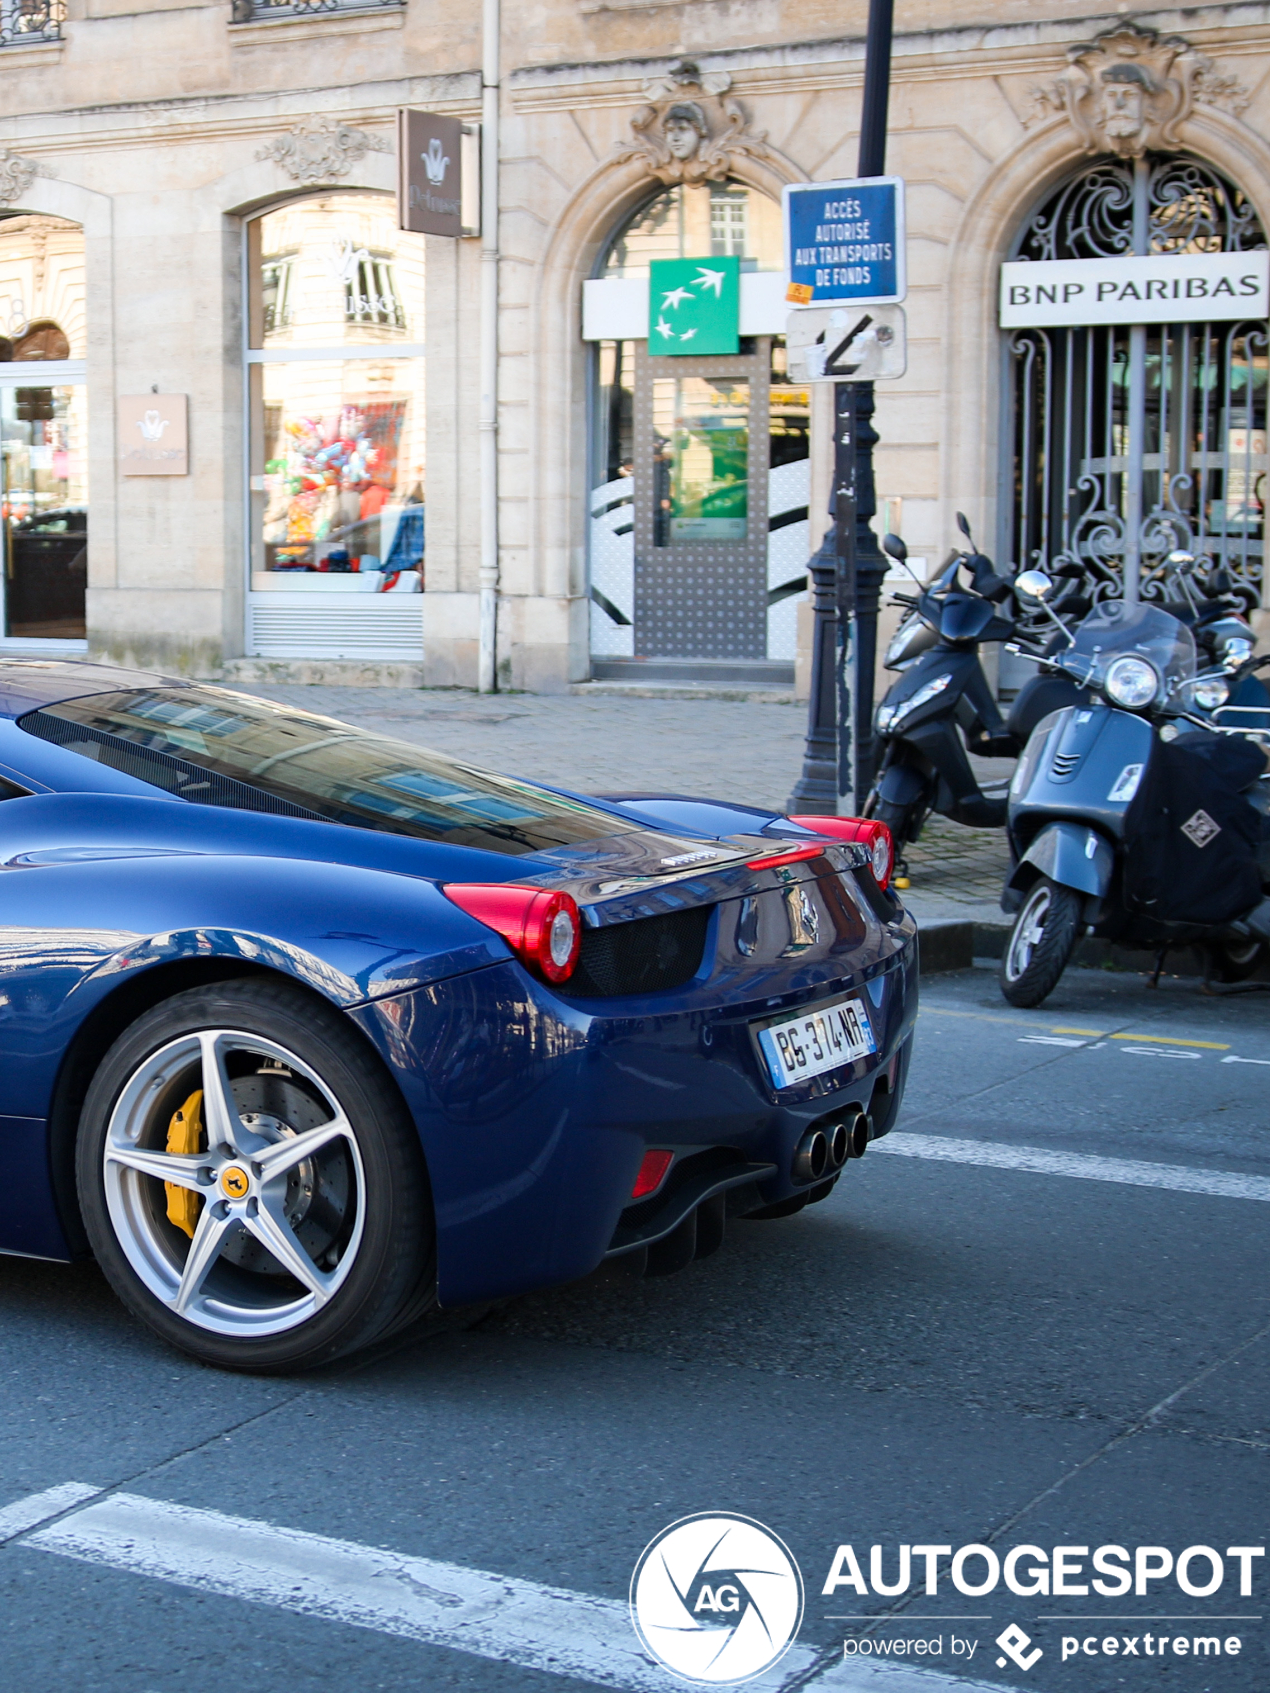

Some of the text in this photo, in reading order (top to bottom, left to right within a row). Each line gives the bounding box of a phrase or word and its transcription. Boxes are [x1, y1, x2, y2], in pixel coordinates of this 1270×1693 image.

[824, 198, 861, 219] ACCÈS
[815, 219, 871, 242] AUTORISÉ
[795, 243, 892, 265] AUX TRANSPORTS
[816, 266, 871, 286] DE FONDS
[1008, 275, 1260, 305] BNP PARIBAS
